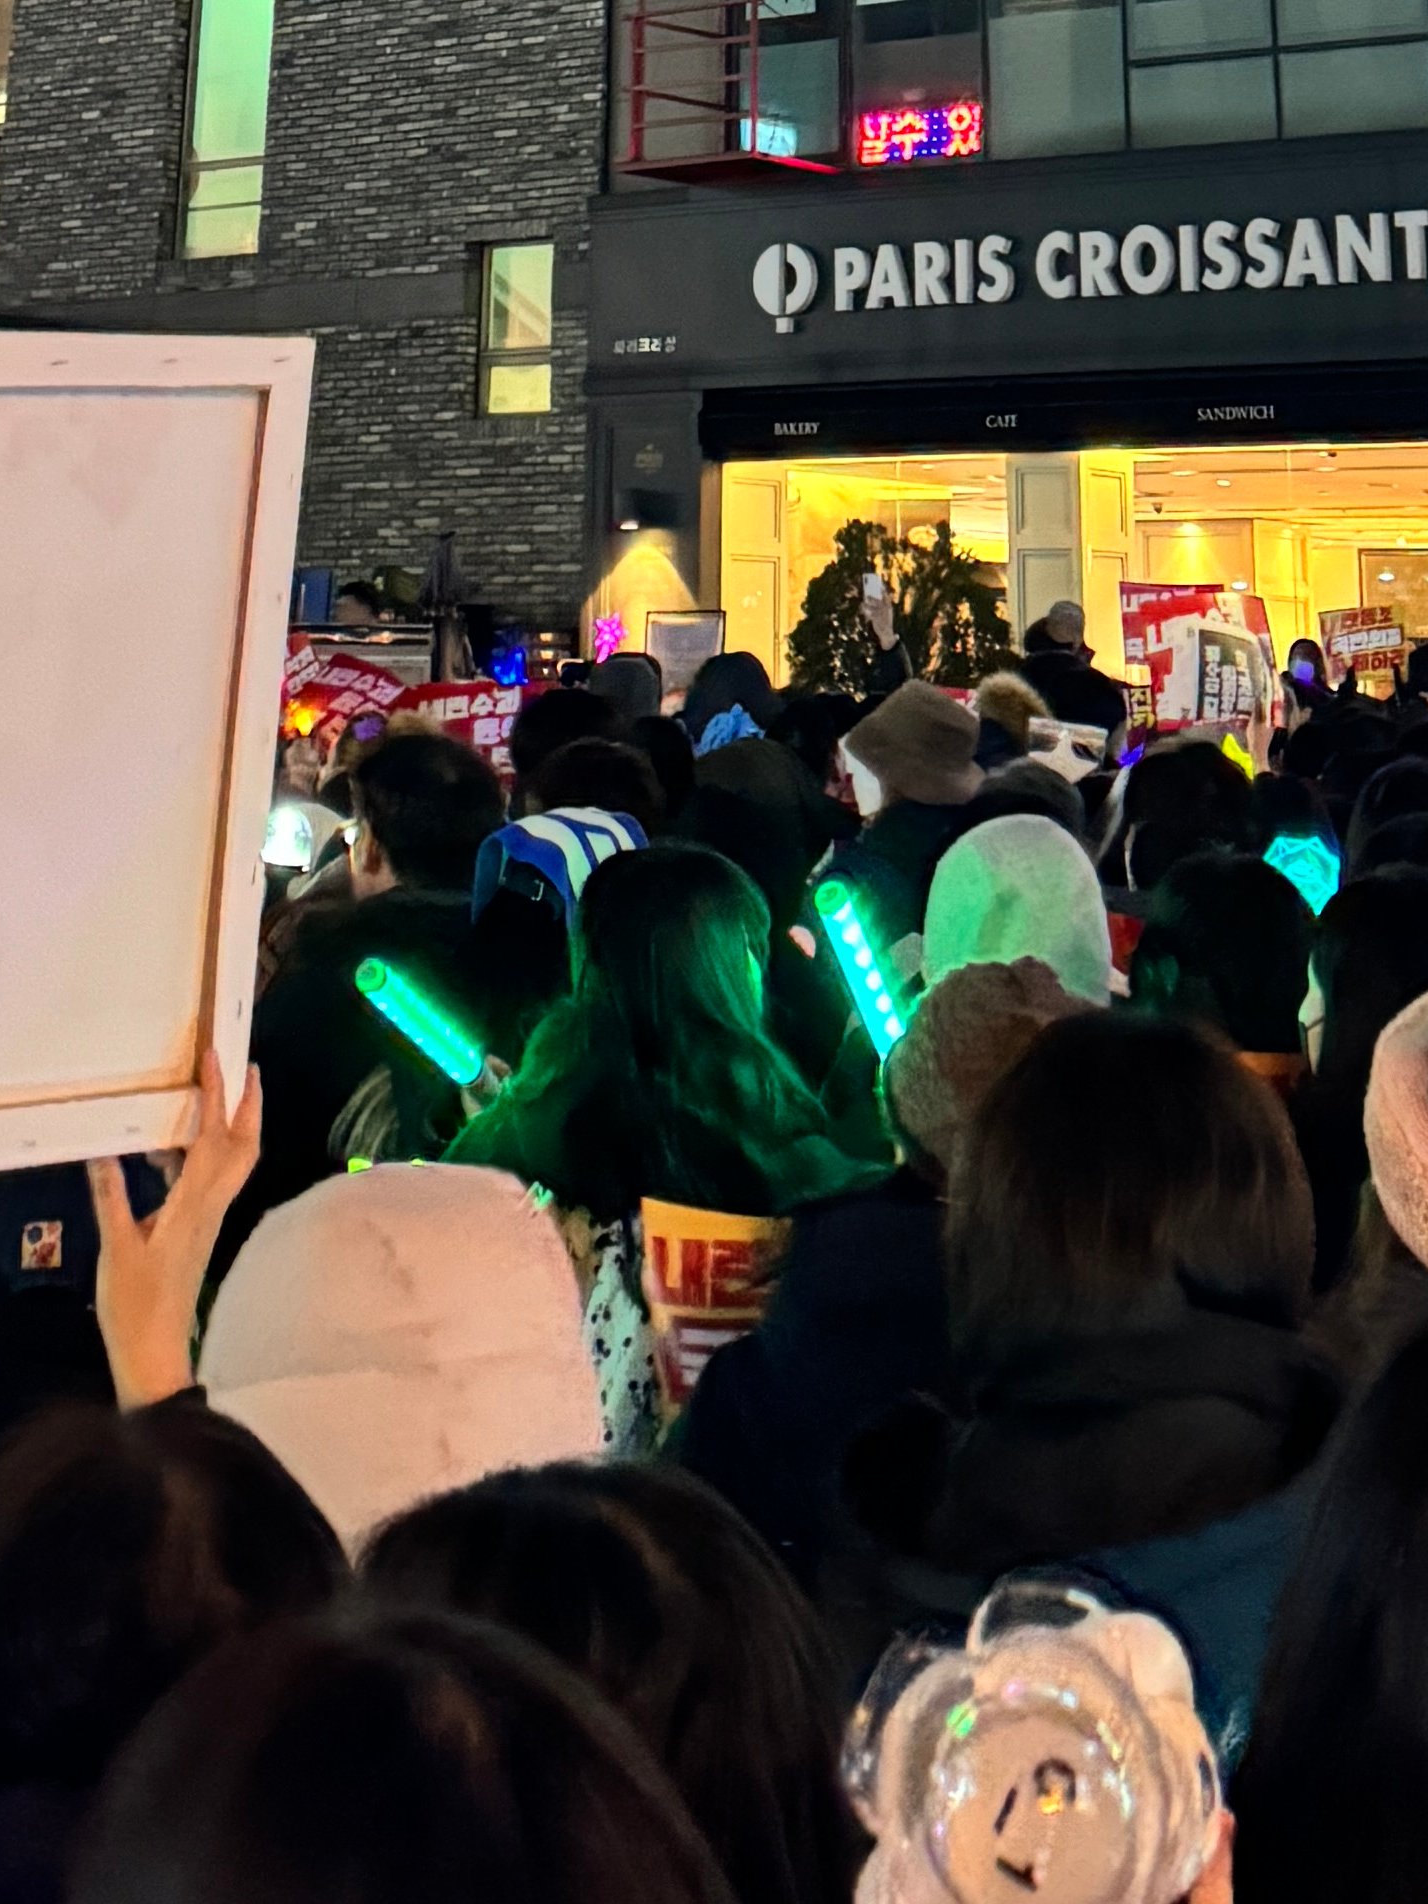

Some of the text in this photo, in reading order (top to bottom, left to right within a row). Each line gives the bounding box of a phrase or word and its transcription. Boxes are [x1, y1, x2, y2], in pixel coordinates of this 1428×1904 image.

[833, 235, 1014, 314] PARIS
[1196, 405, 1275, 422] SANDWICH
[773, 422, 821, 436] BAKERY
